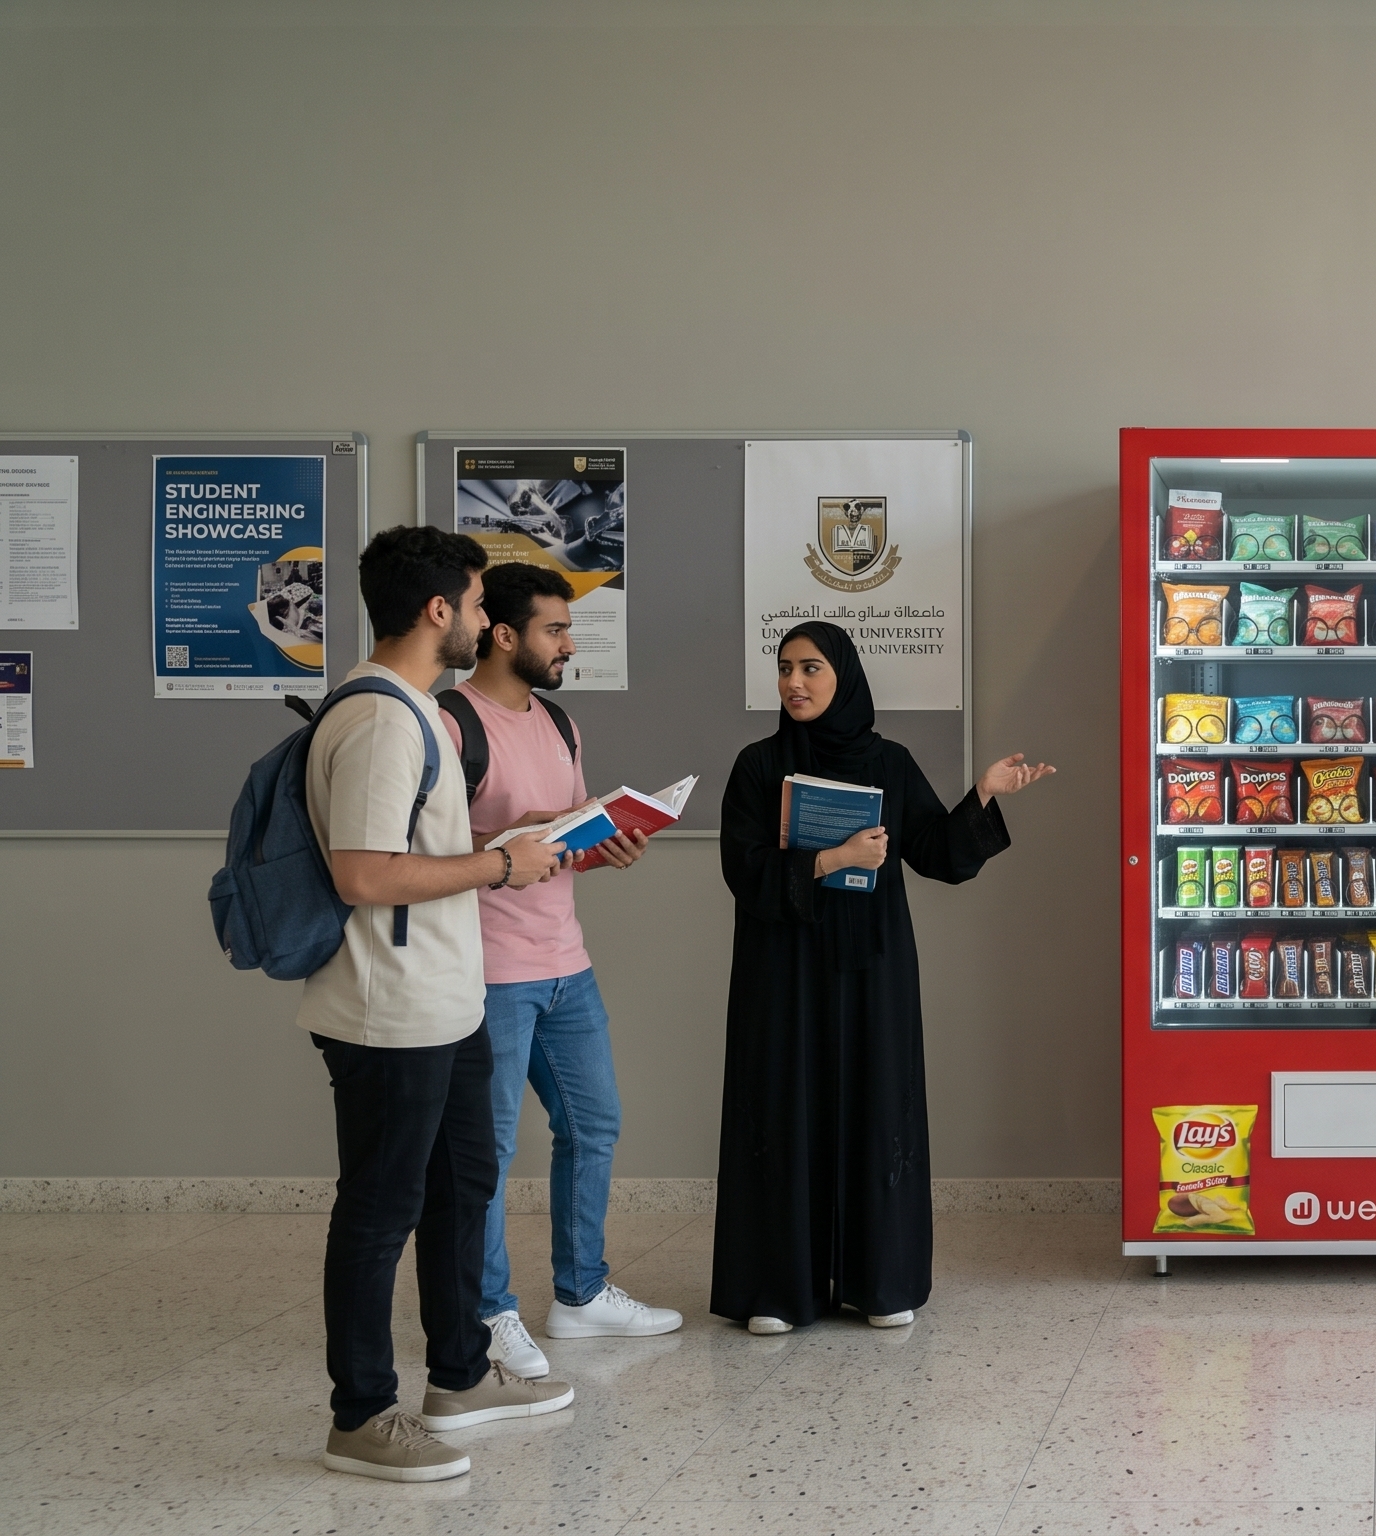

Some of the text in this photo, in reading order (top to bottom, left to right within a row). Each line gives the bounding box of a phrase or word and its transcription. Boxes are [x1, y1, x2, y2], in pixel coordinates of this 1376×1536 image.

[165, 483, 261, 499] STUDENT
[165, 503, 306, 519] ENGINEERING
[165, 523, 283, 539] SHOWCASE
[859, 627, 945, 639] UNIVERSITY
[868, 643, 945, 655] UNIVERSITY
